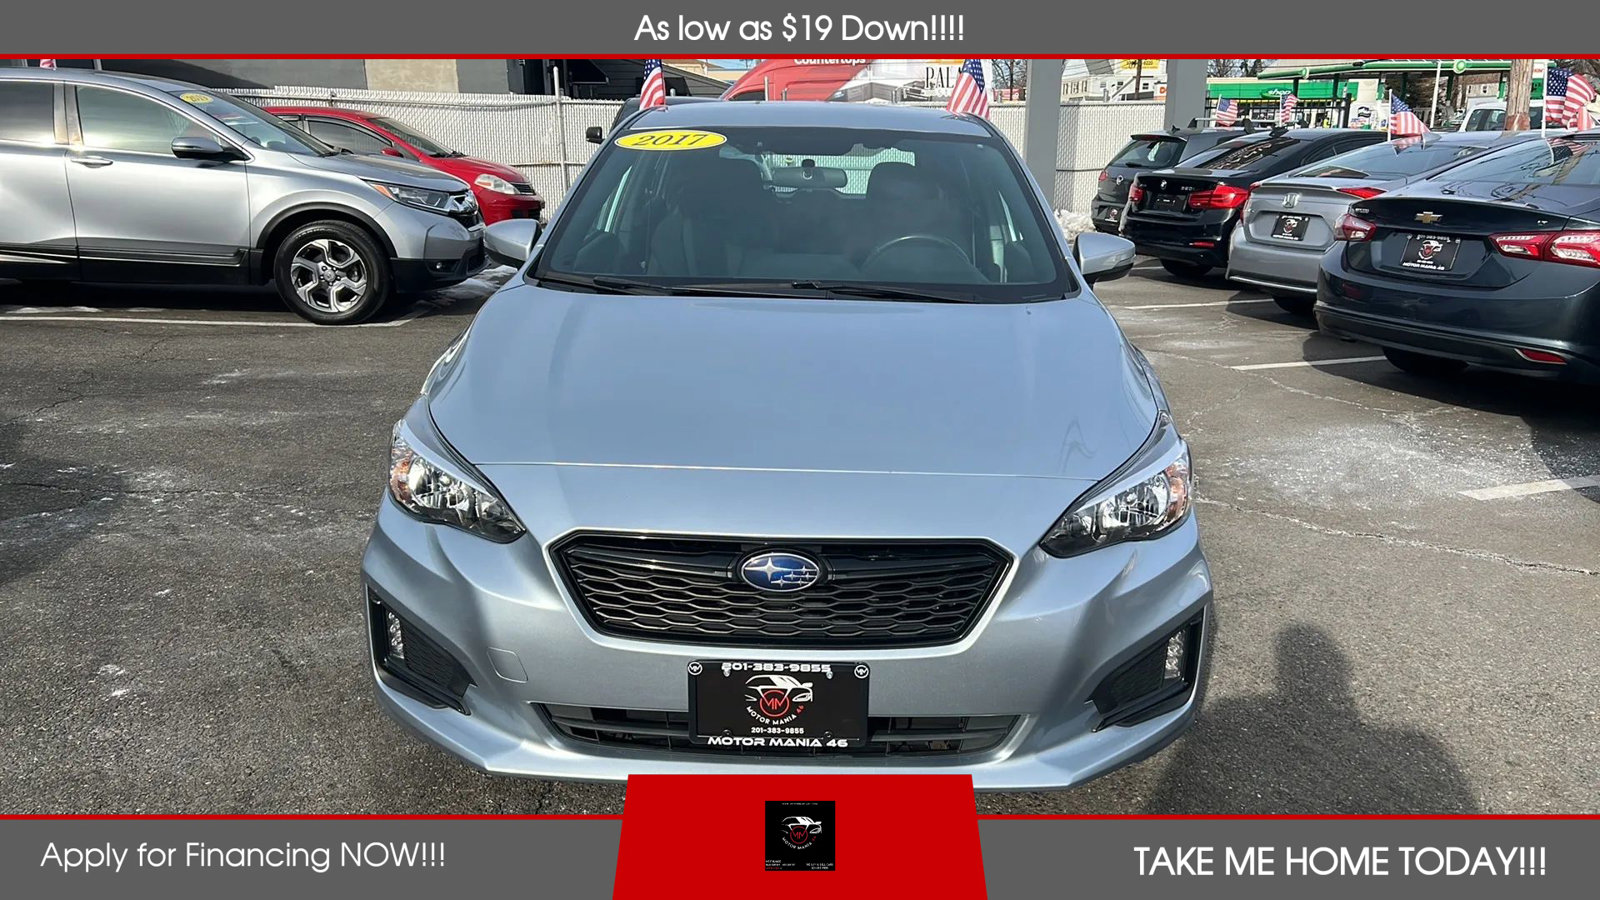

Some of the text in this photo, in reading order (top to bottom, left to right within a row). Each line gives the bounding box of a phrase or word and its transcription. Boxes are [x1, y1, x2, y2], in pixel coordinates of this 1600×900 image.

[926, 67, 962, 88] PAL
[632, 133, 709, 146] 2017
[746, 705, 771, 725] MOTOR
[772, 714, 798, 726] MANIA
[751, 727, 805, 735] 201-383-9855
[707, 736, 849, 748] MOTOR MANIA 46
